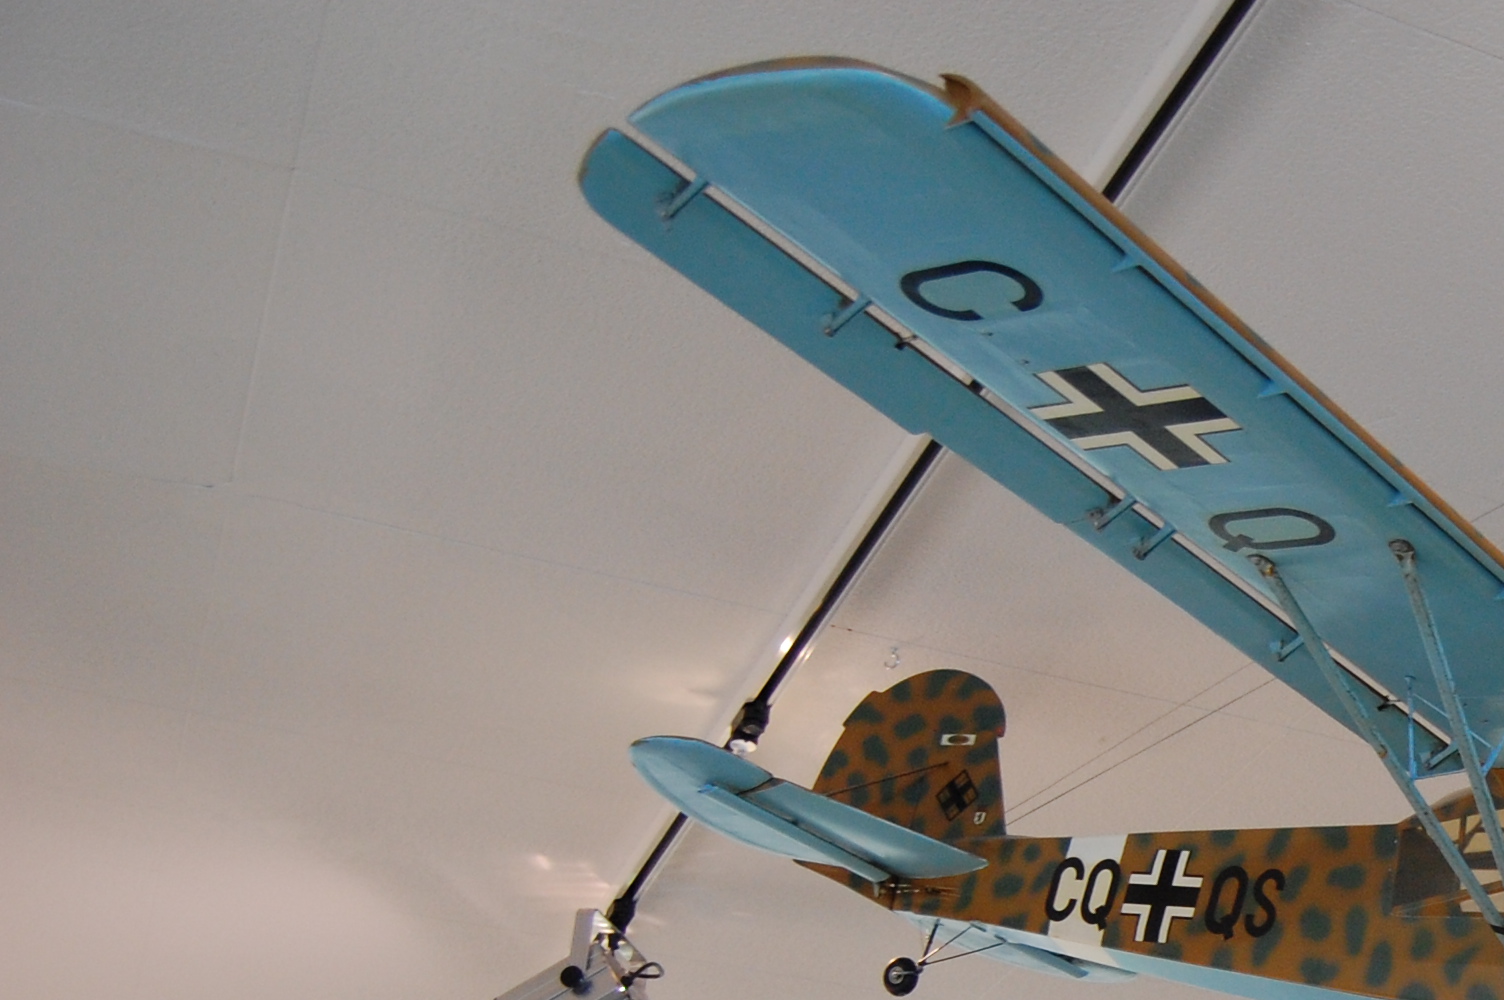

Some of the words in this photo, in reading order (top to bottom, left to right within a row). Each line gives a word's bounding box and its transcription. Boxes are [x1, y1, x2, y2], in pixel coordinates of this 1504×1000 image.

[899, 260, 1044, 321] C
[1208, 507, 1336, 552] Q
[1045, 857, 1121, 930] CQ
[1205, 866, 1285, 940] QS
